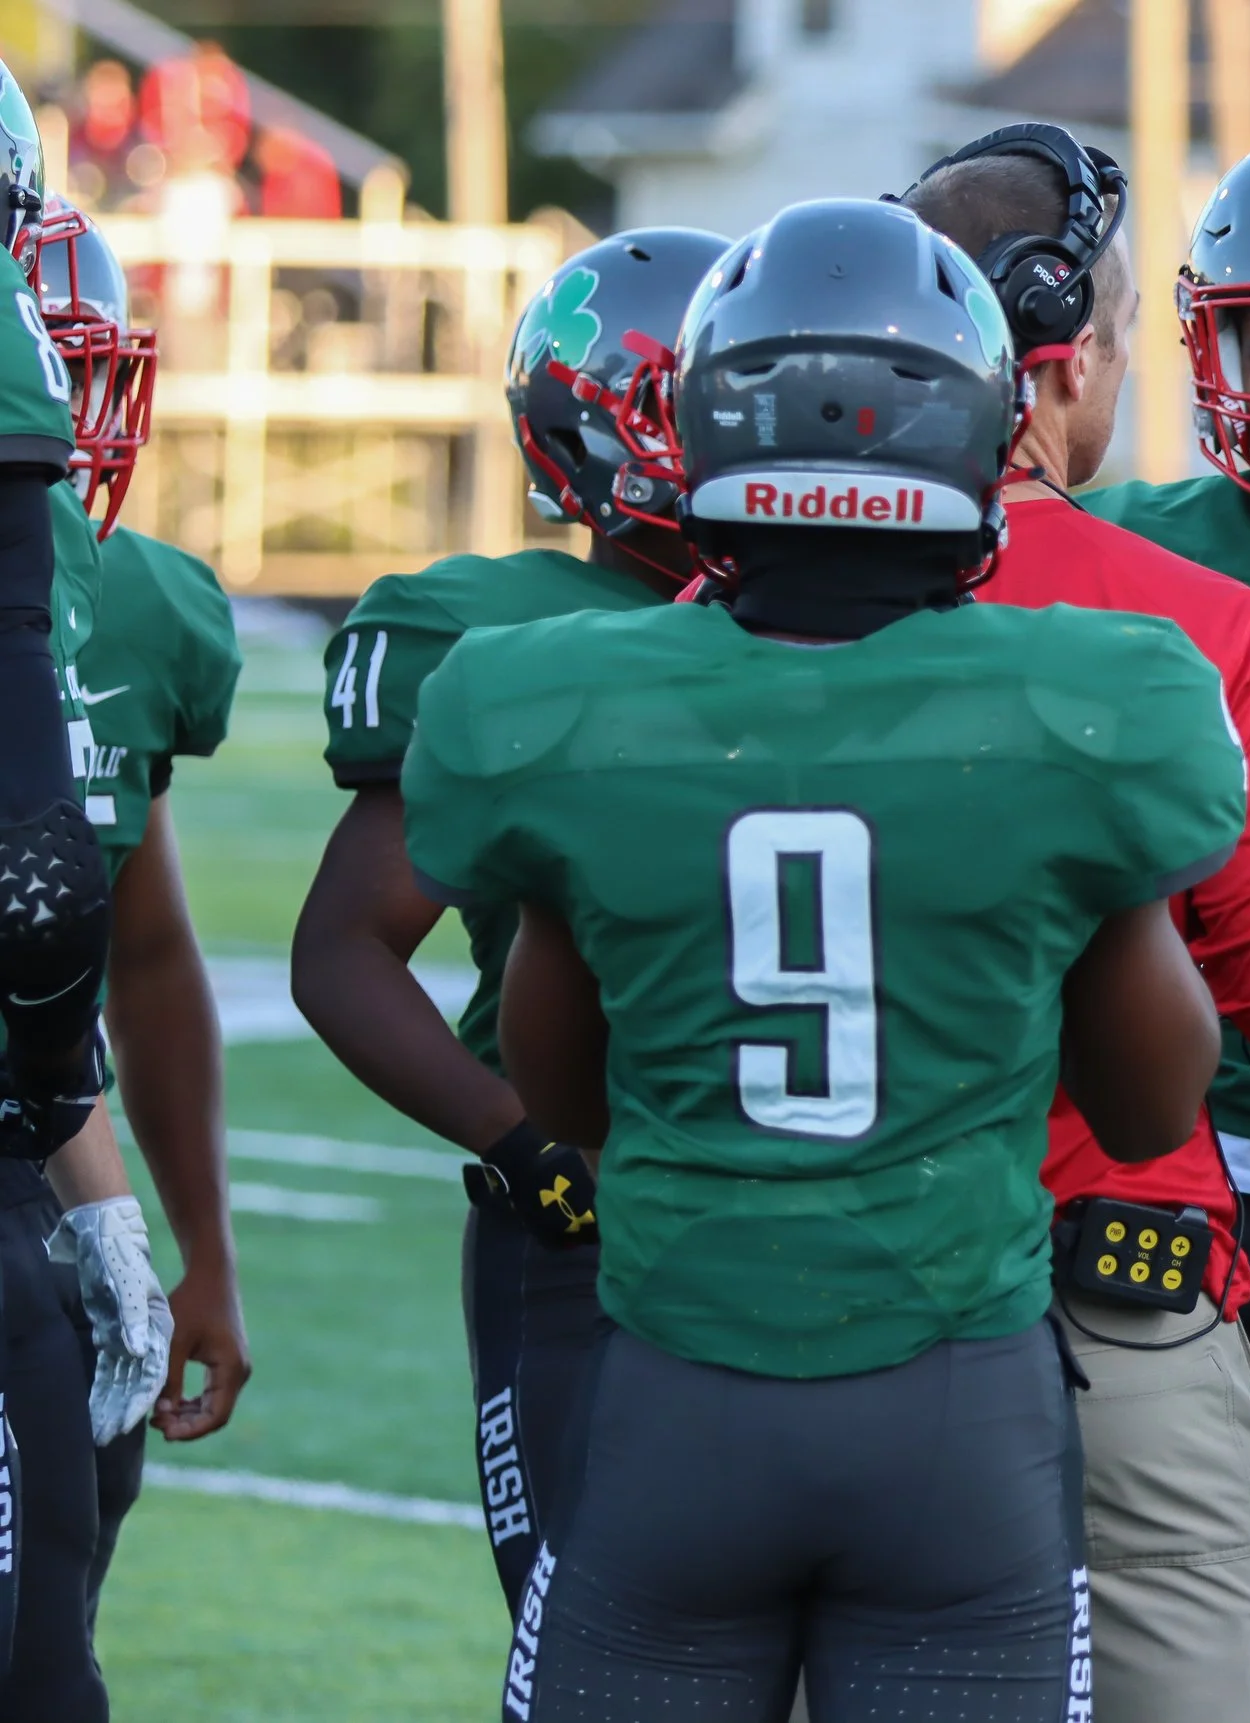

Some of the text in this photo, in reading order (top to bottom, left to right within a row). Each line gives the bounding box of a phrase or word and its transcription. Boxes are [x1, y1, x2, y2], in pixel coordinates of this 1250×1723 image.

[745, 482, 924, 523] Riddell
[332, 630, 388, 728] 41
[726, 808, 879, 1141] 9
[1103, 1260, 1112, 1269] M
[1137, 1251, 1152, 1261] VOL
[1171, 1259, 1182, 1267] CH
[481, 1386, 531, 1547] IRISH
[506, 1540, 557, 1722] IRISH
